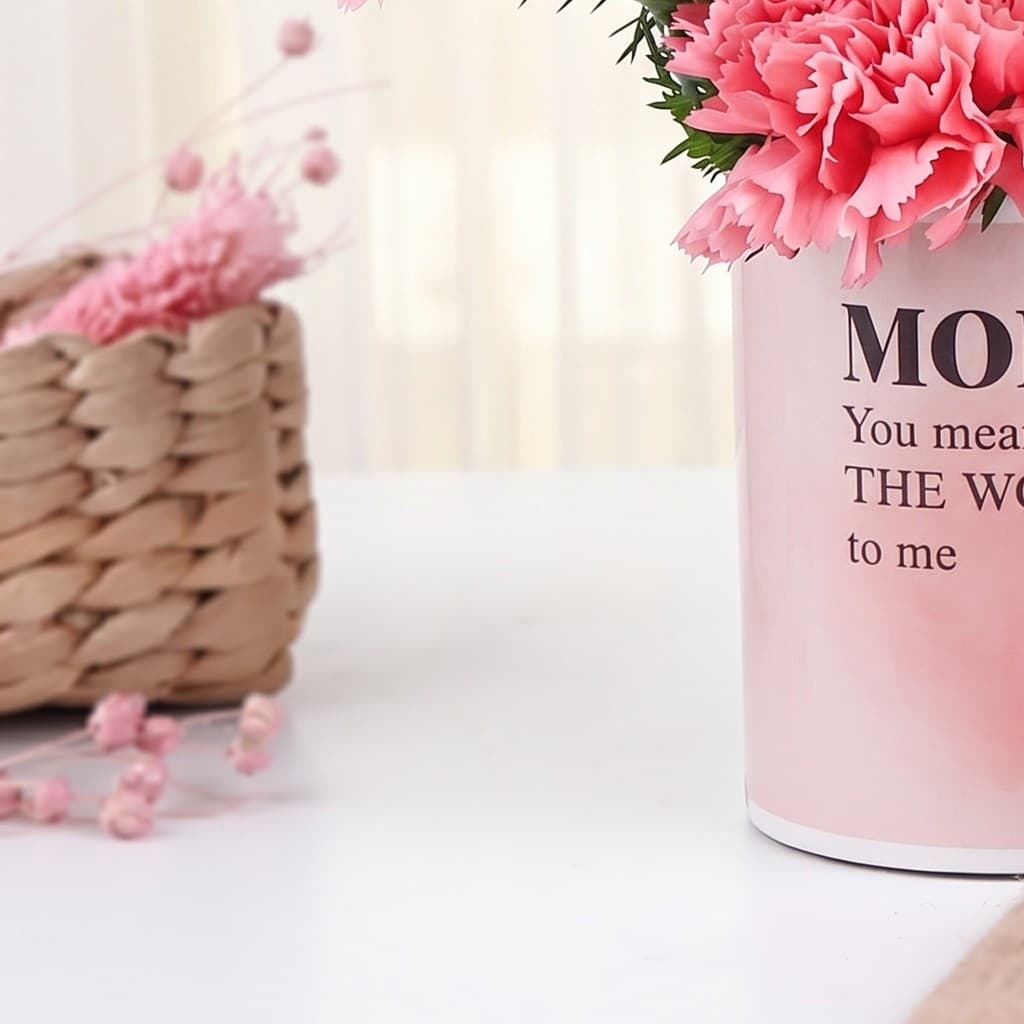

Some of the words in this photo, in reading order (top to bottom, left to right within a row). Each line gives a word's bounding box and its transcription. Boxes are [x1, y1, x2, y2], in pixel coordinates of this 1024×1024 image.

[842, 404, 919, 448] You
[844, 465, 947, 510] THE
[847, 532, 882, 566] to
[896, 543, 957, 571] me
